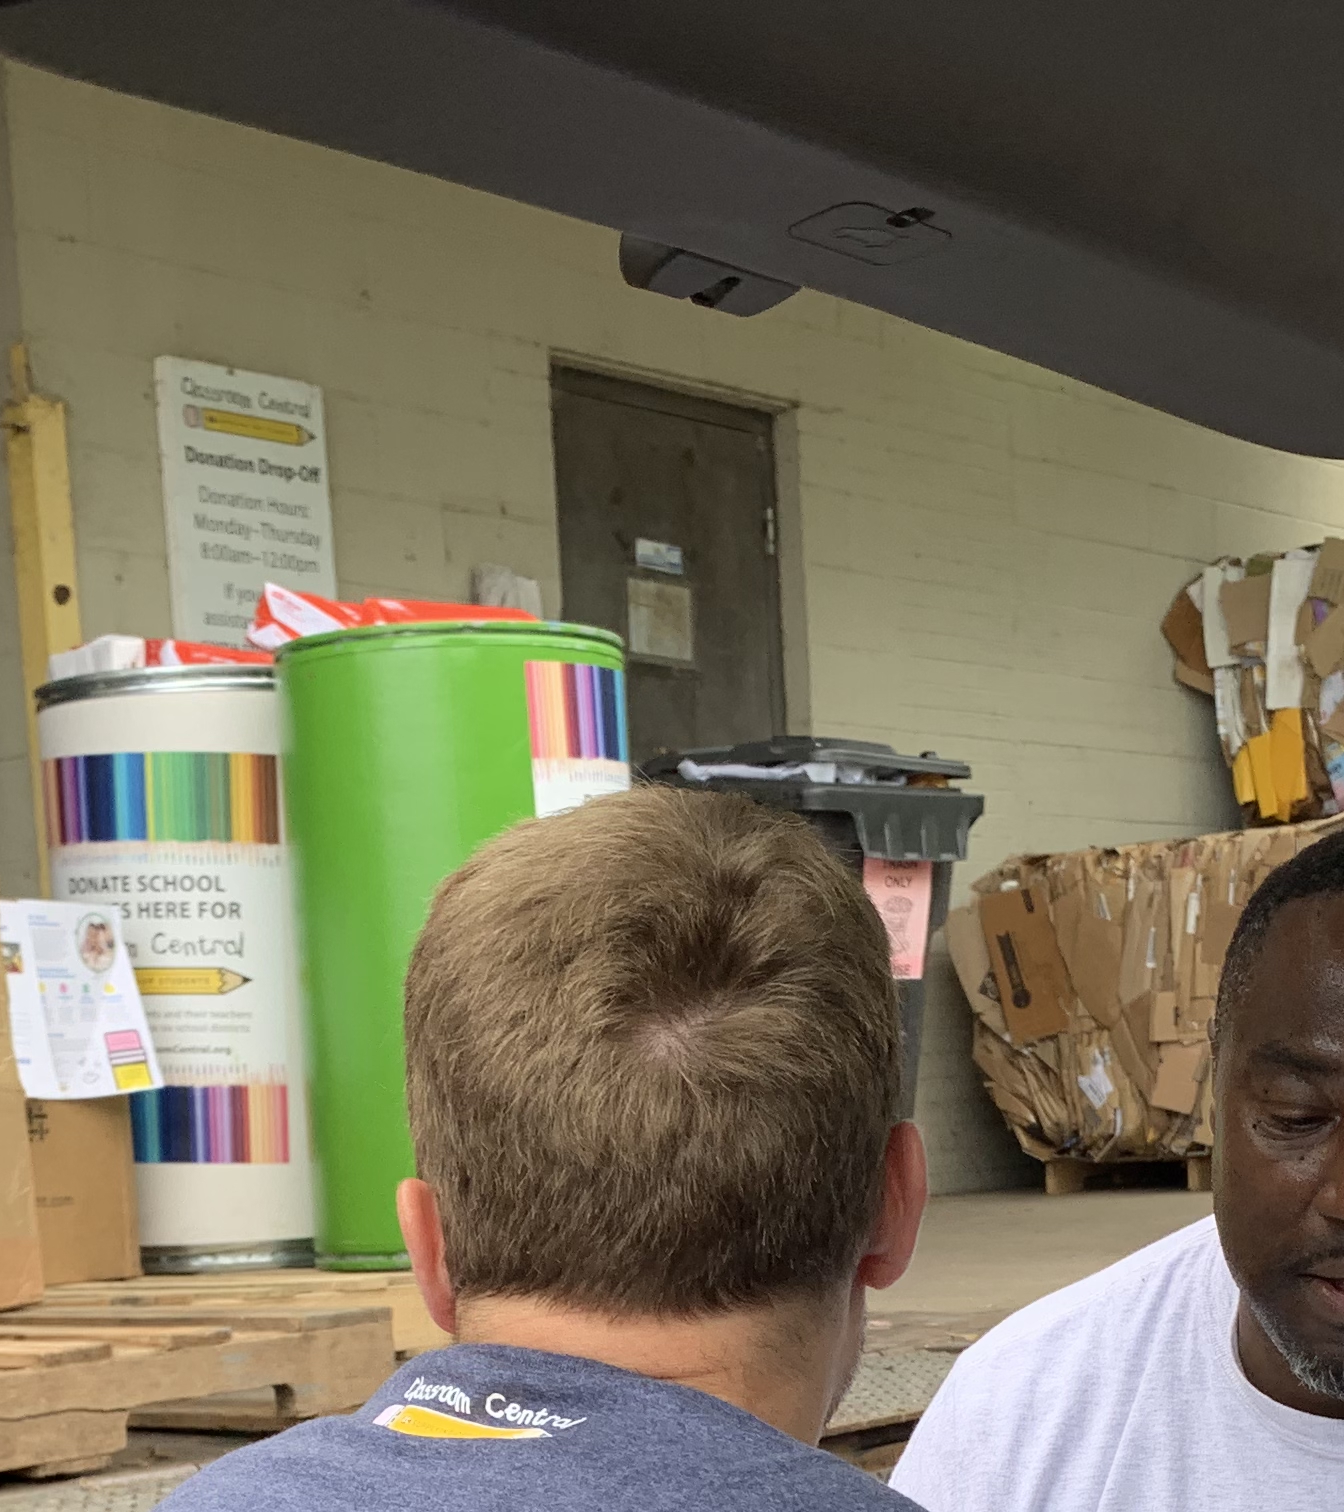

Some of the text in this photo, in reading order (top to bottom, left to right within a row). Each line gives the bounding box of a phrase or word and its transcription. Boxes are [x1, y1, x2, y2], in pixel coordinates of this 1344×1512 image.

[184, 445, 322, 484] Donation Drop-Off
[68, 874, 227, 895] DONATE SCHOOL
[883, 875, 913, 889] ONLY
[137, 902, 192, 919] HERE
[198, 901, 243, 919] FOR
[151, 931, 246, 959] Central
[403, 1376, 471, 1415] Classroom
[484, 1392, 588, 1430] Central
